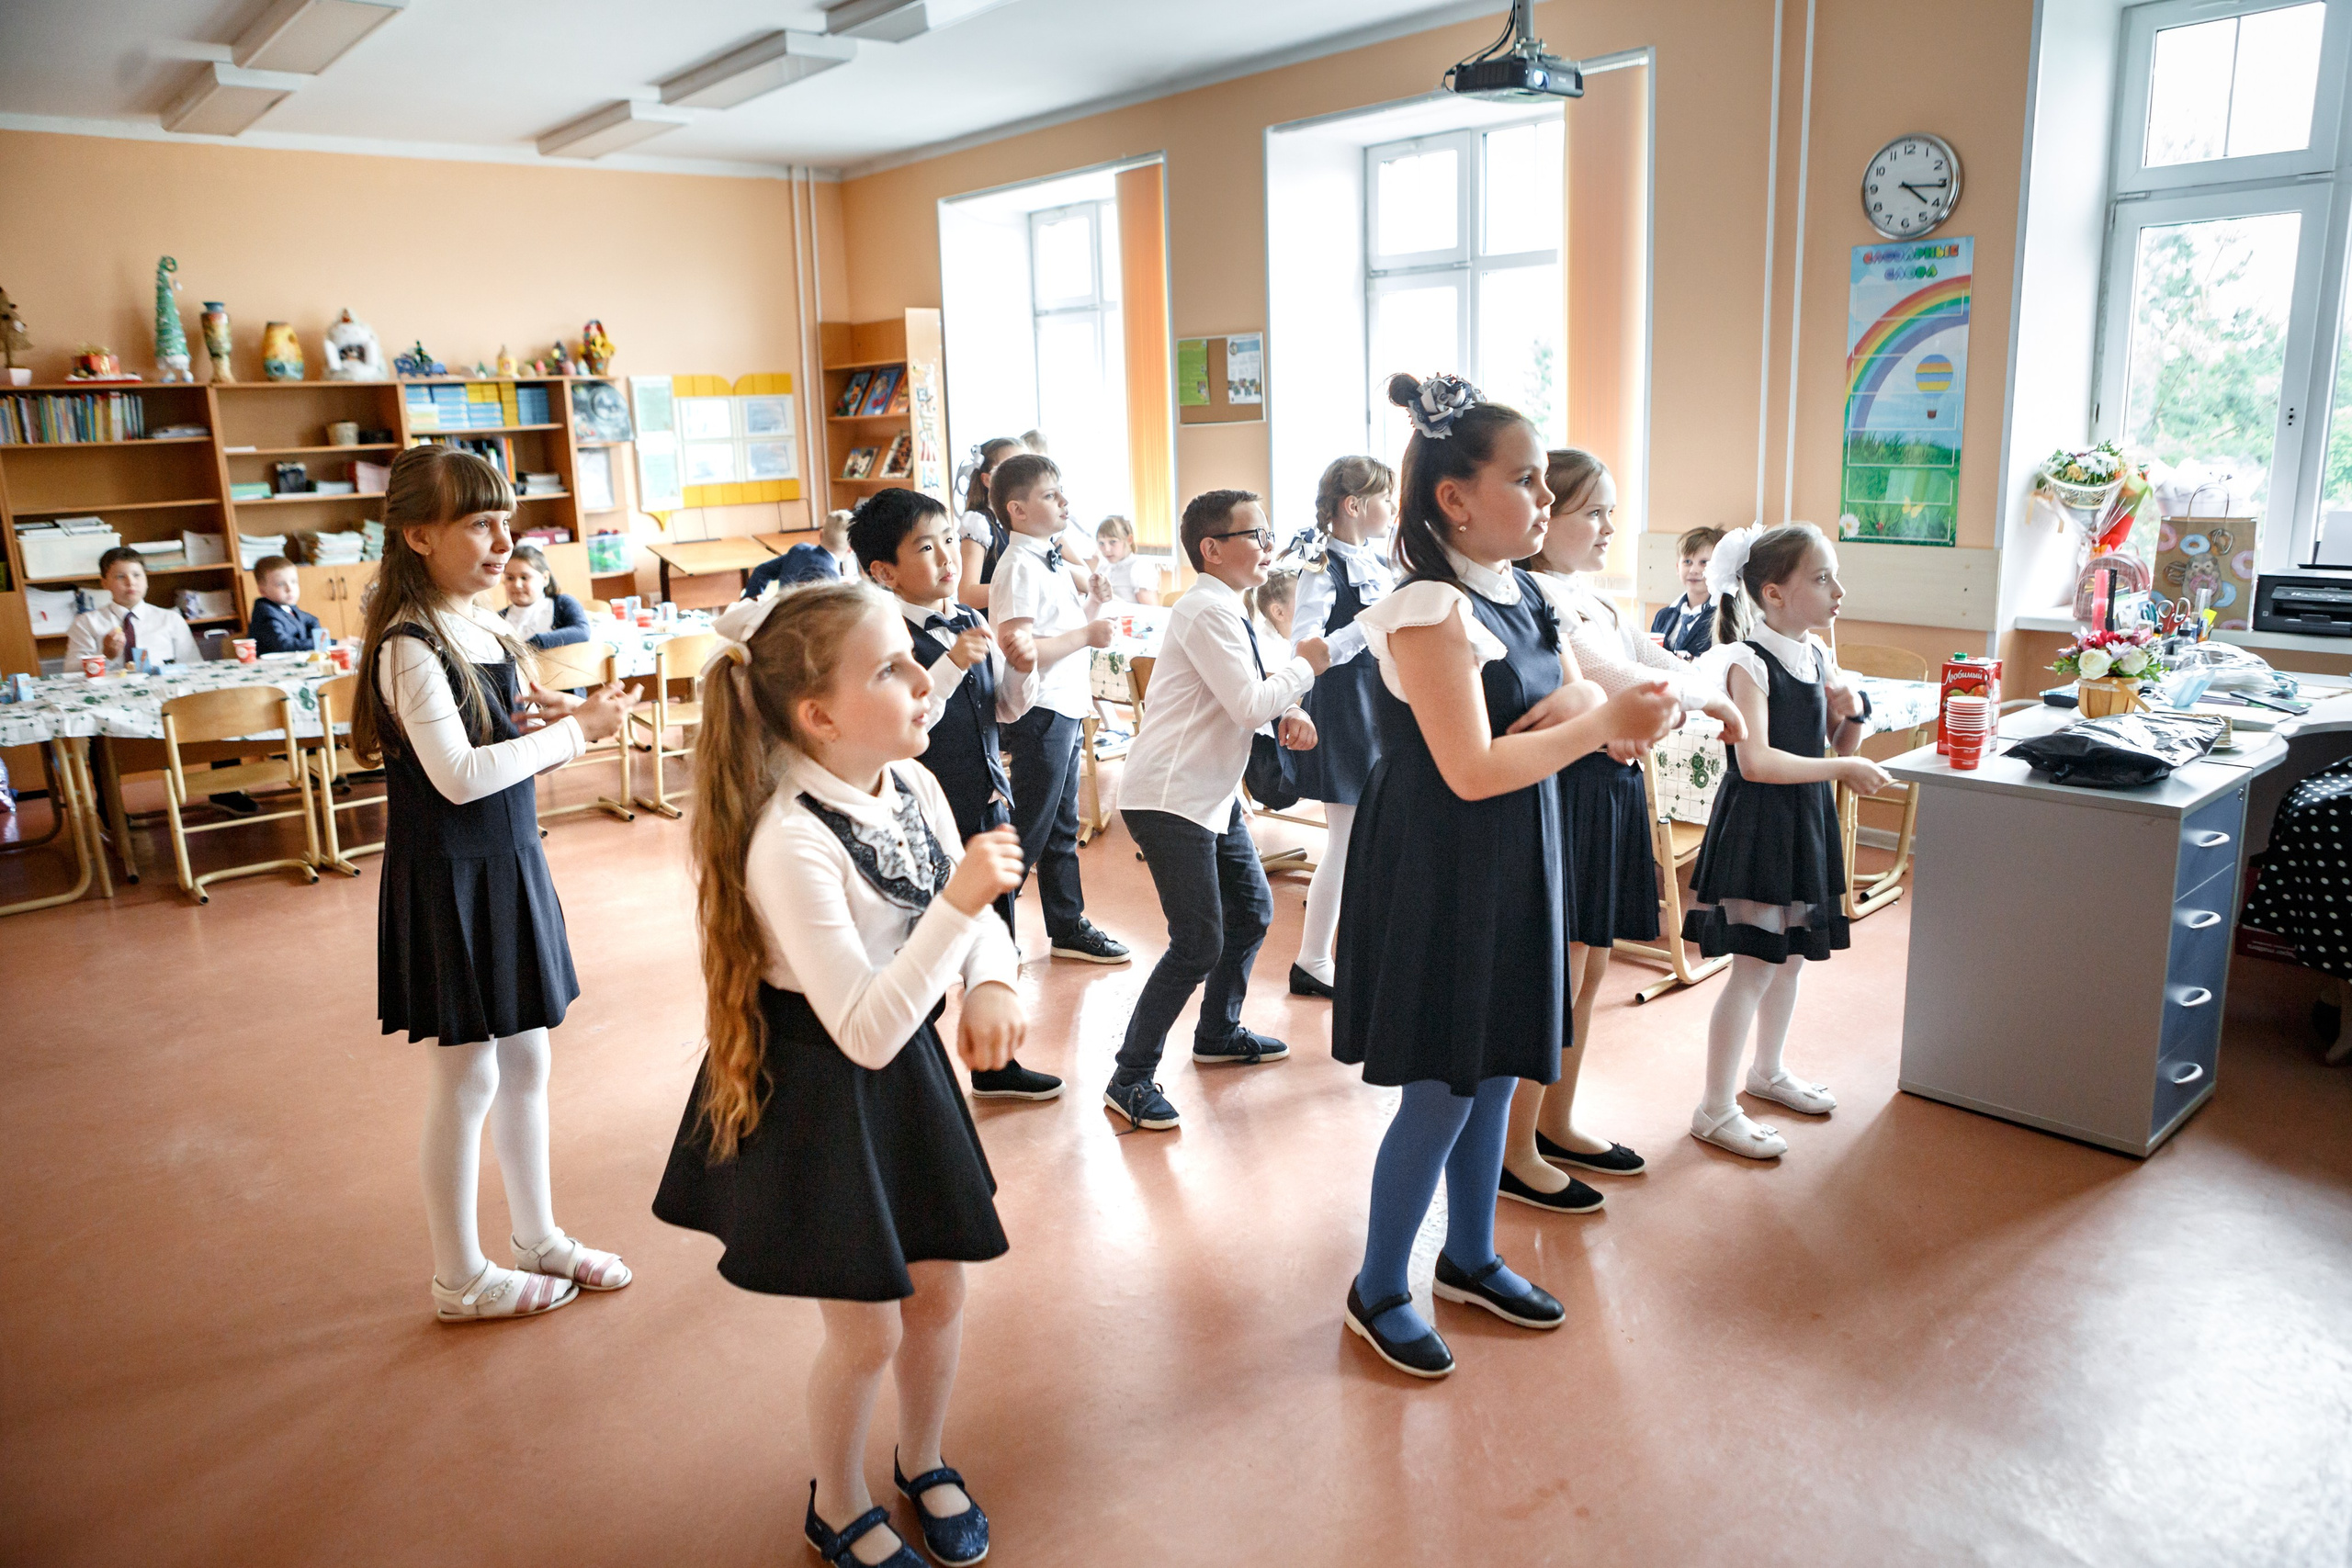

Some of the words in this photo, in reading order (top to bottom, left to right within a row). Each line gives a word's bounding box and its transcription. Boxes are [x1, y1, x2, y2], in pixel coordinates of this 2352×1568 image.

[1904, 143, 1917, 156] 12
[1926, 147, 1929, 158] 1
[1890, 151, 1897, 162] 11
[1875, 165, 1886, 177] 10
[1933, 159, 1944, 171] 2
[1869, 184, 1879, 196] 9
[1872, 201, 1883, 213] 8
[1931, 197, 1940, 208] 4
[1884, 214, 1894, 226] 7
[1918, 211, 1928, 222] 5
[1900, 217, 1910, 230] 6
[1863, 244, 1959, 265] СЛОВАРНЫЕ
[1884, 264, 1938, 280] СЛОВА
[1941, 669, 1984, 686] Любимый
